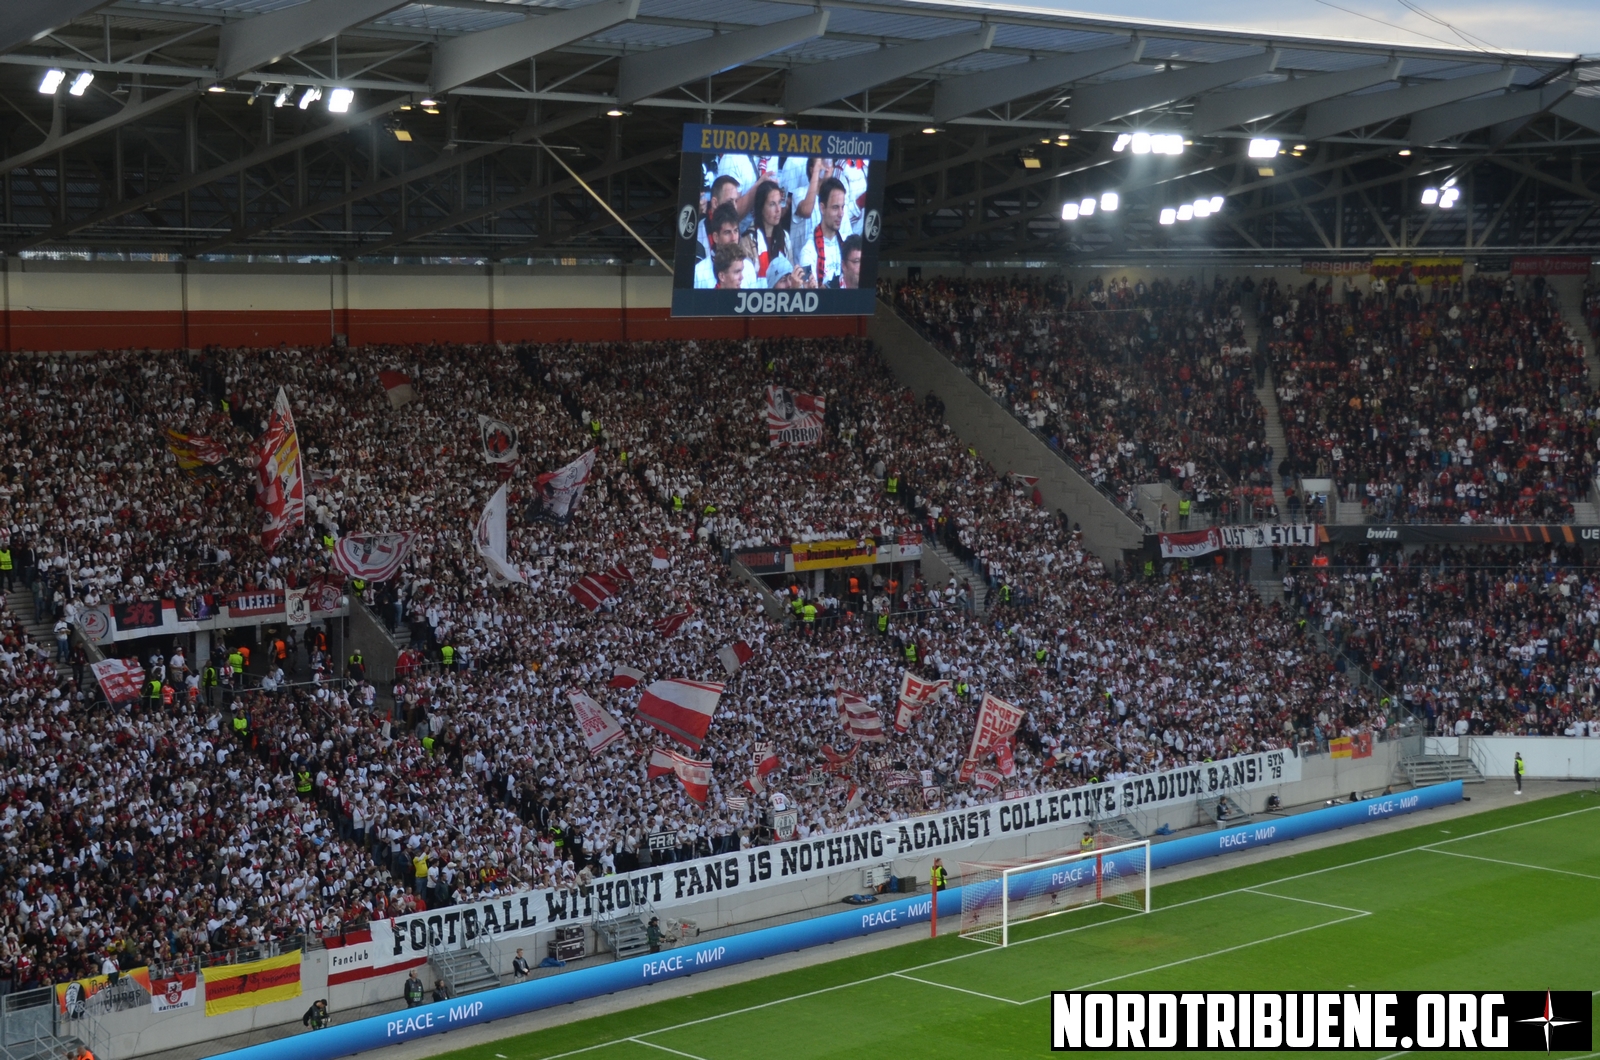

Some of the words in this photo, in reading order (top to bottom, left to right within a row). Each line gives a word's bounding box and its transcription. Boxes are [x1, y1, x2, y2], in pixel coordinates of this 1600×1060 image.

[701, 129, 771, 151] EUROPA
[777, 133, 823, 153] PARK
[827, 135, 873, 156] Stadion
[1302, 261, 1371, 274] FREIBURG
[734, 291, 819, 314] JOBRAD
[778, 427, 819, 443] ZORROS
[1223, 528, 1245, 545] LIST
[1271, 526, 1312, 543] SYLT
[1366, 527, 1398, 539] bwin
[238, 593, 275, 611] U.F.F.F.!
[985, 698, 1020, 724] SPORT
[1267, 752, 1285, 767] SYN
[1271, 766, 1282, 779] 79
[775, 797, 783, 805] 12
[1368, 801, 1393, 816] PEACE
[1400, 795, 1419, 809] МИР
[1219, 832, 1247, 848] PEACE
[1255, 826, 1276, 841] МИР
[392, 897, 537, 956] FOOTBALL
[546, 872, 664, 923] WITHOUT
[674, 856, 740, 899] FANS
[749, 852, 772, 884] IS
[999, 786, 1116, 834] COLLECTIVE
[1122, 769, 1204, 808] STADIUM
[1207, 757, 1262, 792] BANS!
[1052, 867, 1082, 885] PEACE
[862, 908, 897, 928] PEACE
[908, 900, 933, 918] МИР
[333, 949, 369, 967] Fanclub
[643, 955, 683, 978] PEACE
[695, 946, 726, 966] МИР
[387, 1012, 434, 1037] PEACE
[449, 1001, 483, 1023] МИР
